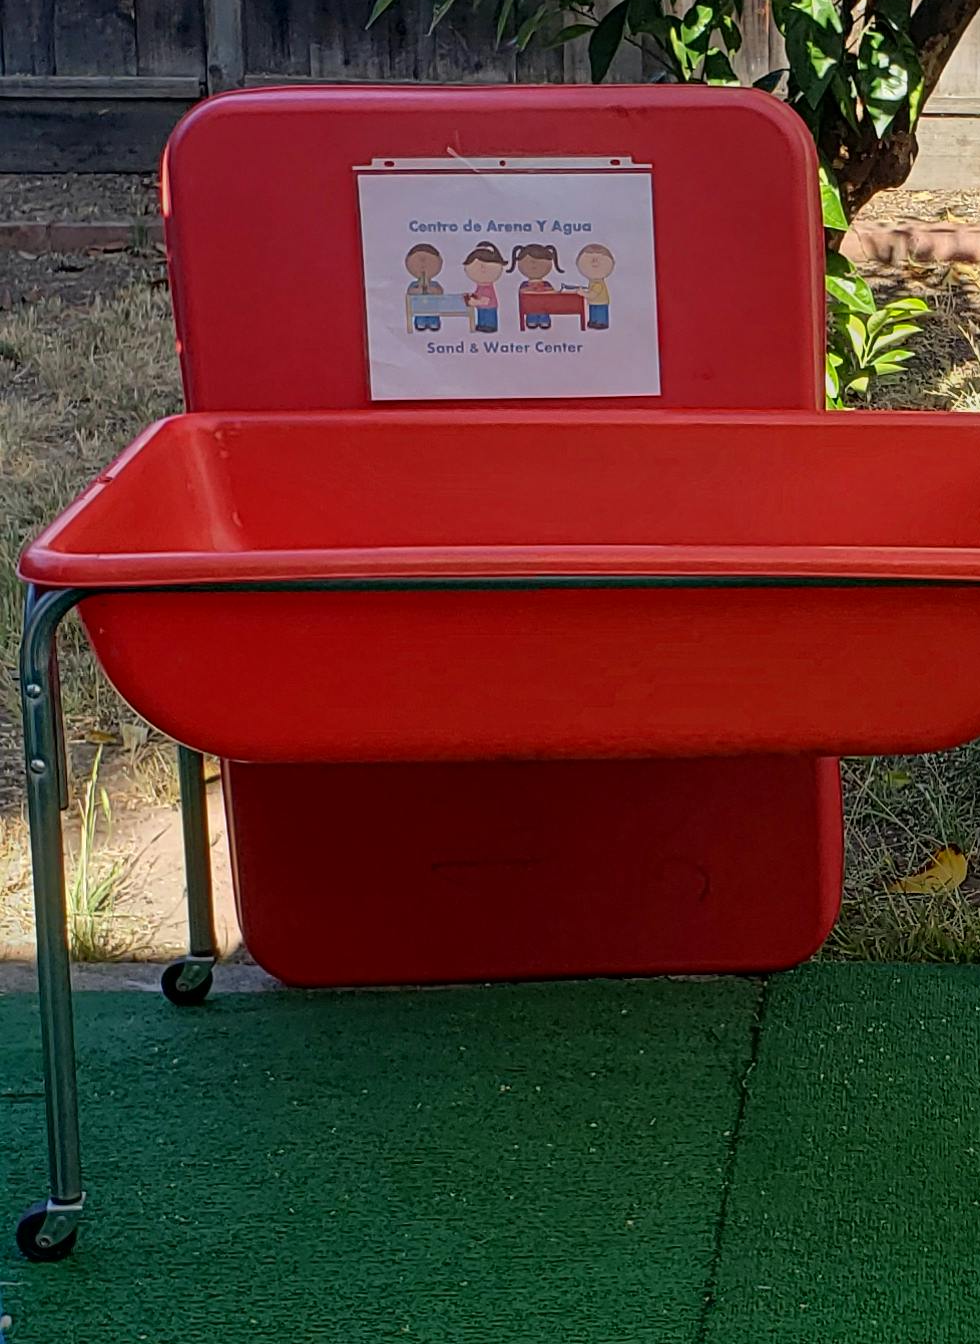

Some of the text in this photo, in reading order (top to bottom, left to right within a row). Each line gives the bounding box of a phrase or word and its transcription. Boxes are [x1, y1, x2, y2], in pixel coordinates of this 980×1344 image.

[409, 220, 592, 235] Centro de Arena Y Agua
[427, 341, 583, 354] Sand & Water Center
